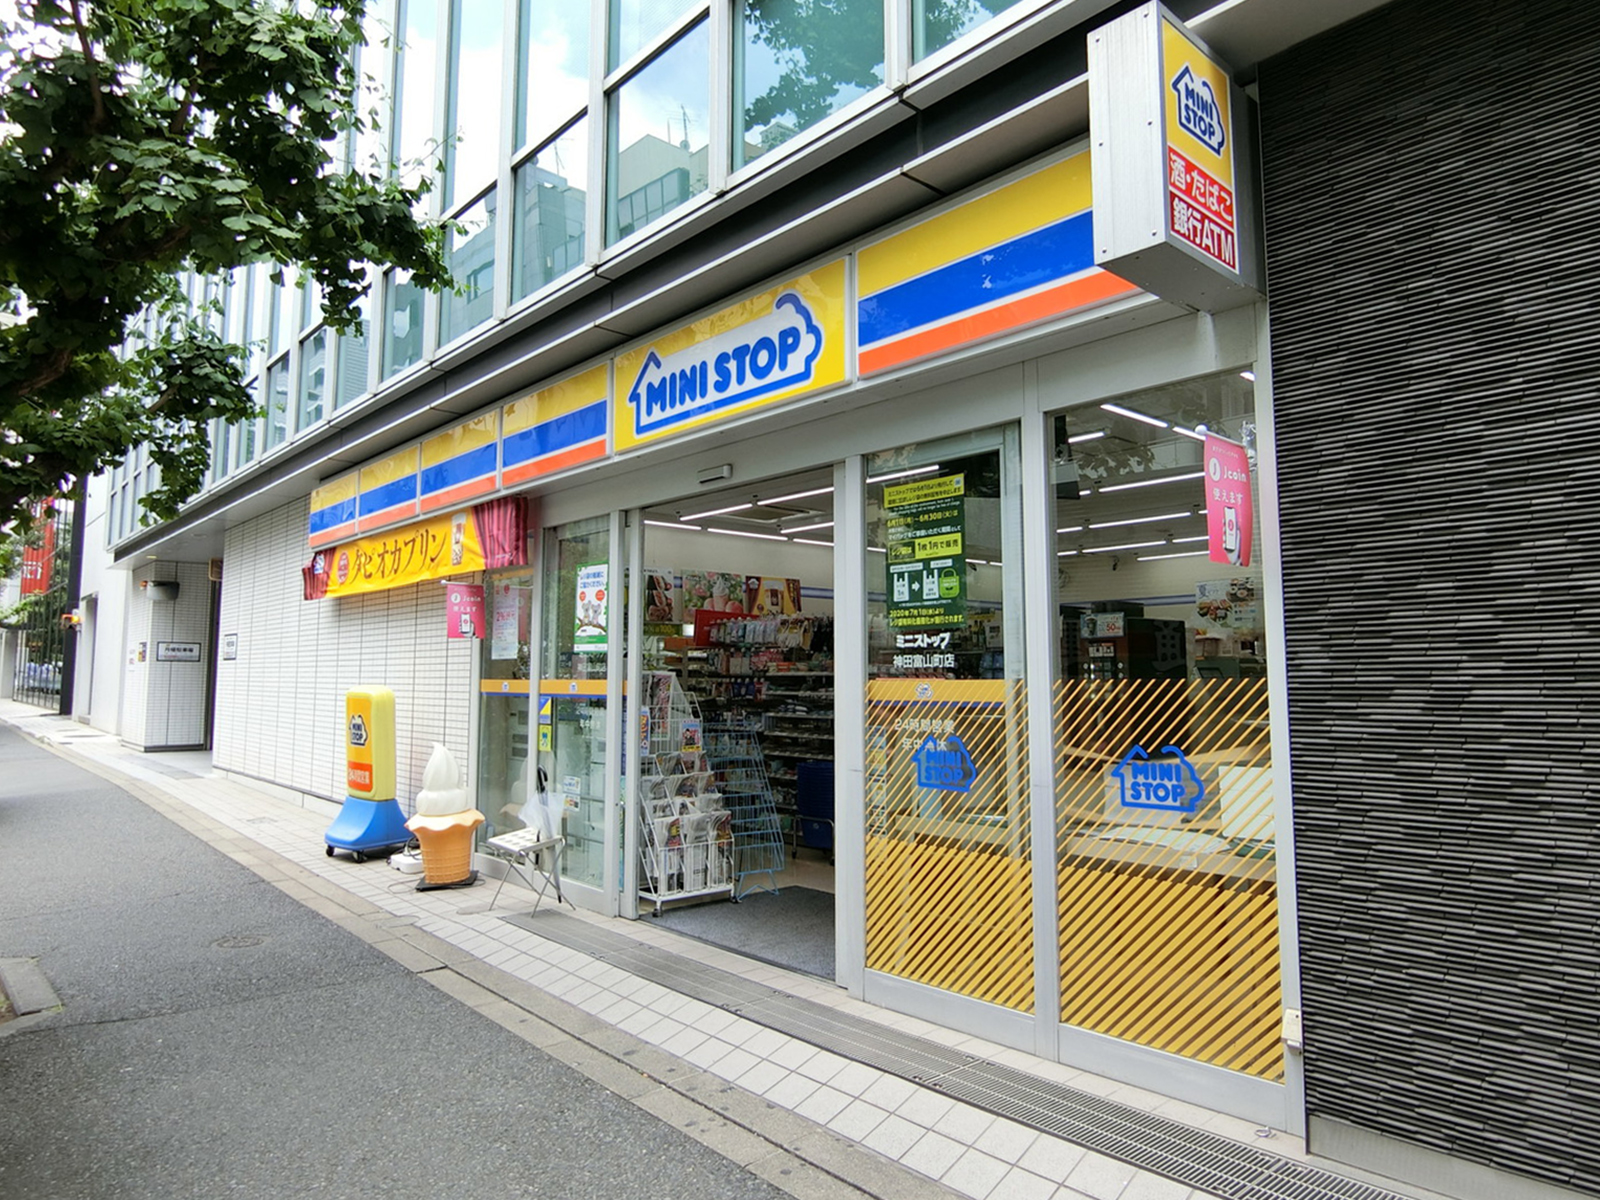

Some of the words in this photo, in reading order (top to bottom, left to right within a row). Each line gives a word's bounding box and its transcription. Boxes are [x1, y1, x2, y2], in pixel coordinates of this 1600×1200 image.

[1184, 81, 1214, 121] MINI
[1183, 105, 1216, 142] STOP
[1170, 152, 1233, 222] 酒・たばこ
[1173, 197, 1235, 267] 銀行ATM
[645, 360, 708, 418] MINI
[713, 325, 801, 394] STOP
[1223, 465, 1247, 482] Jcoin
[1213, 487, 1244, 505] 使えます
[350, 529, 447, 585] タピオカプリン
[896, 632, 951, 650] ミニストップ
[893, 653, 955, 669] 神田富山町店
[894, 718, 955, 734] 24時間営業
[926, 750, 962, 767] MINI
[924, 765, 964, 784] STOP
[1131, 761, 1182, 783] MINI
[1130, 781, 1187, 803] STOP
